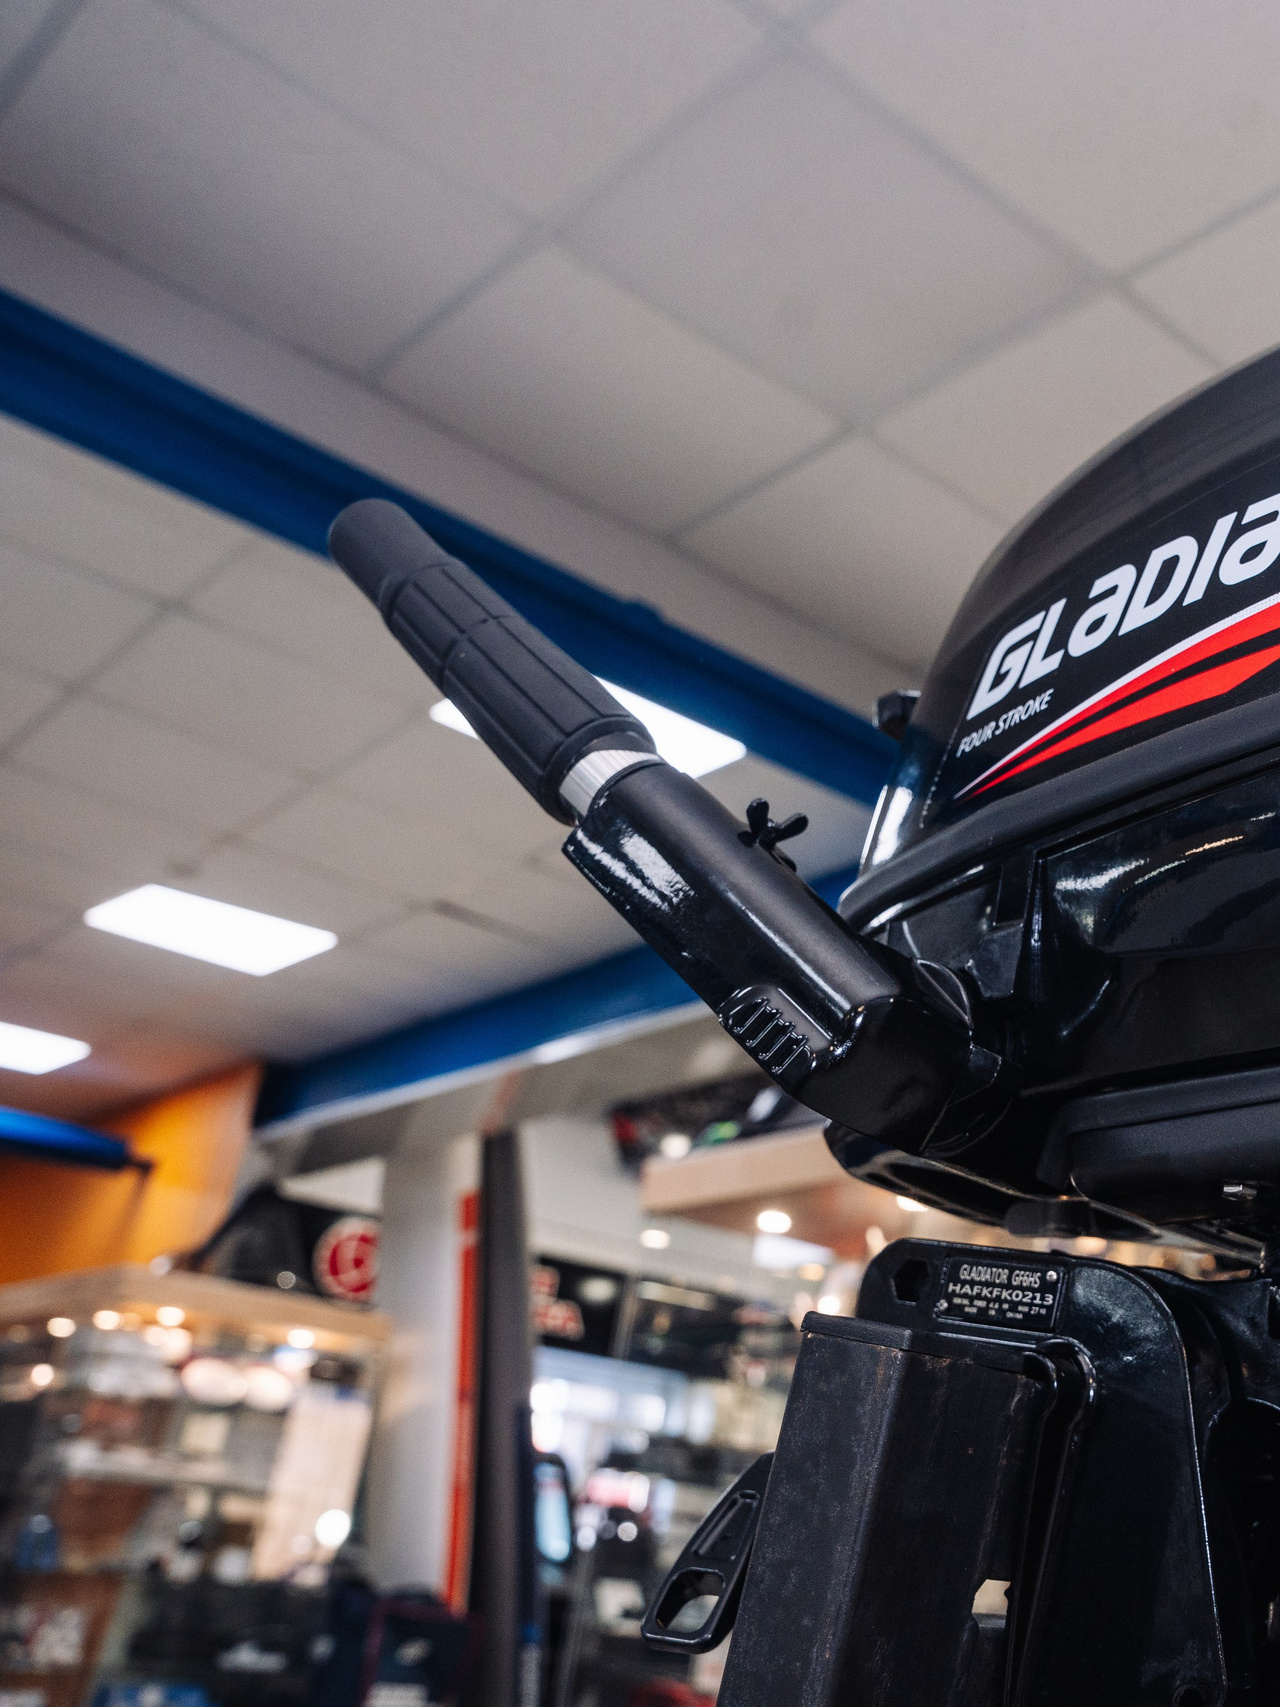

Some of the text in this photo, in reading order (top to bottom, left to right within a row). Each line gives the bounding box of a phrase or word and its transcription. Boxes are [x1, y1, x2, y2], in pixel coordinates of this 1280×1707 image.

[956, 688, 1054, 758] FOUR STROKE
[959, 1264, 1041, 1288] GLADIATOR GF6HS
[948, 1282, 1053, 1305] HAFKFK0213
